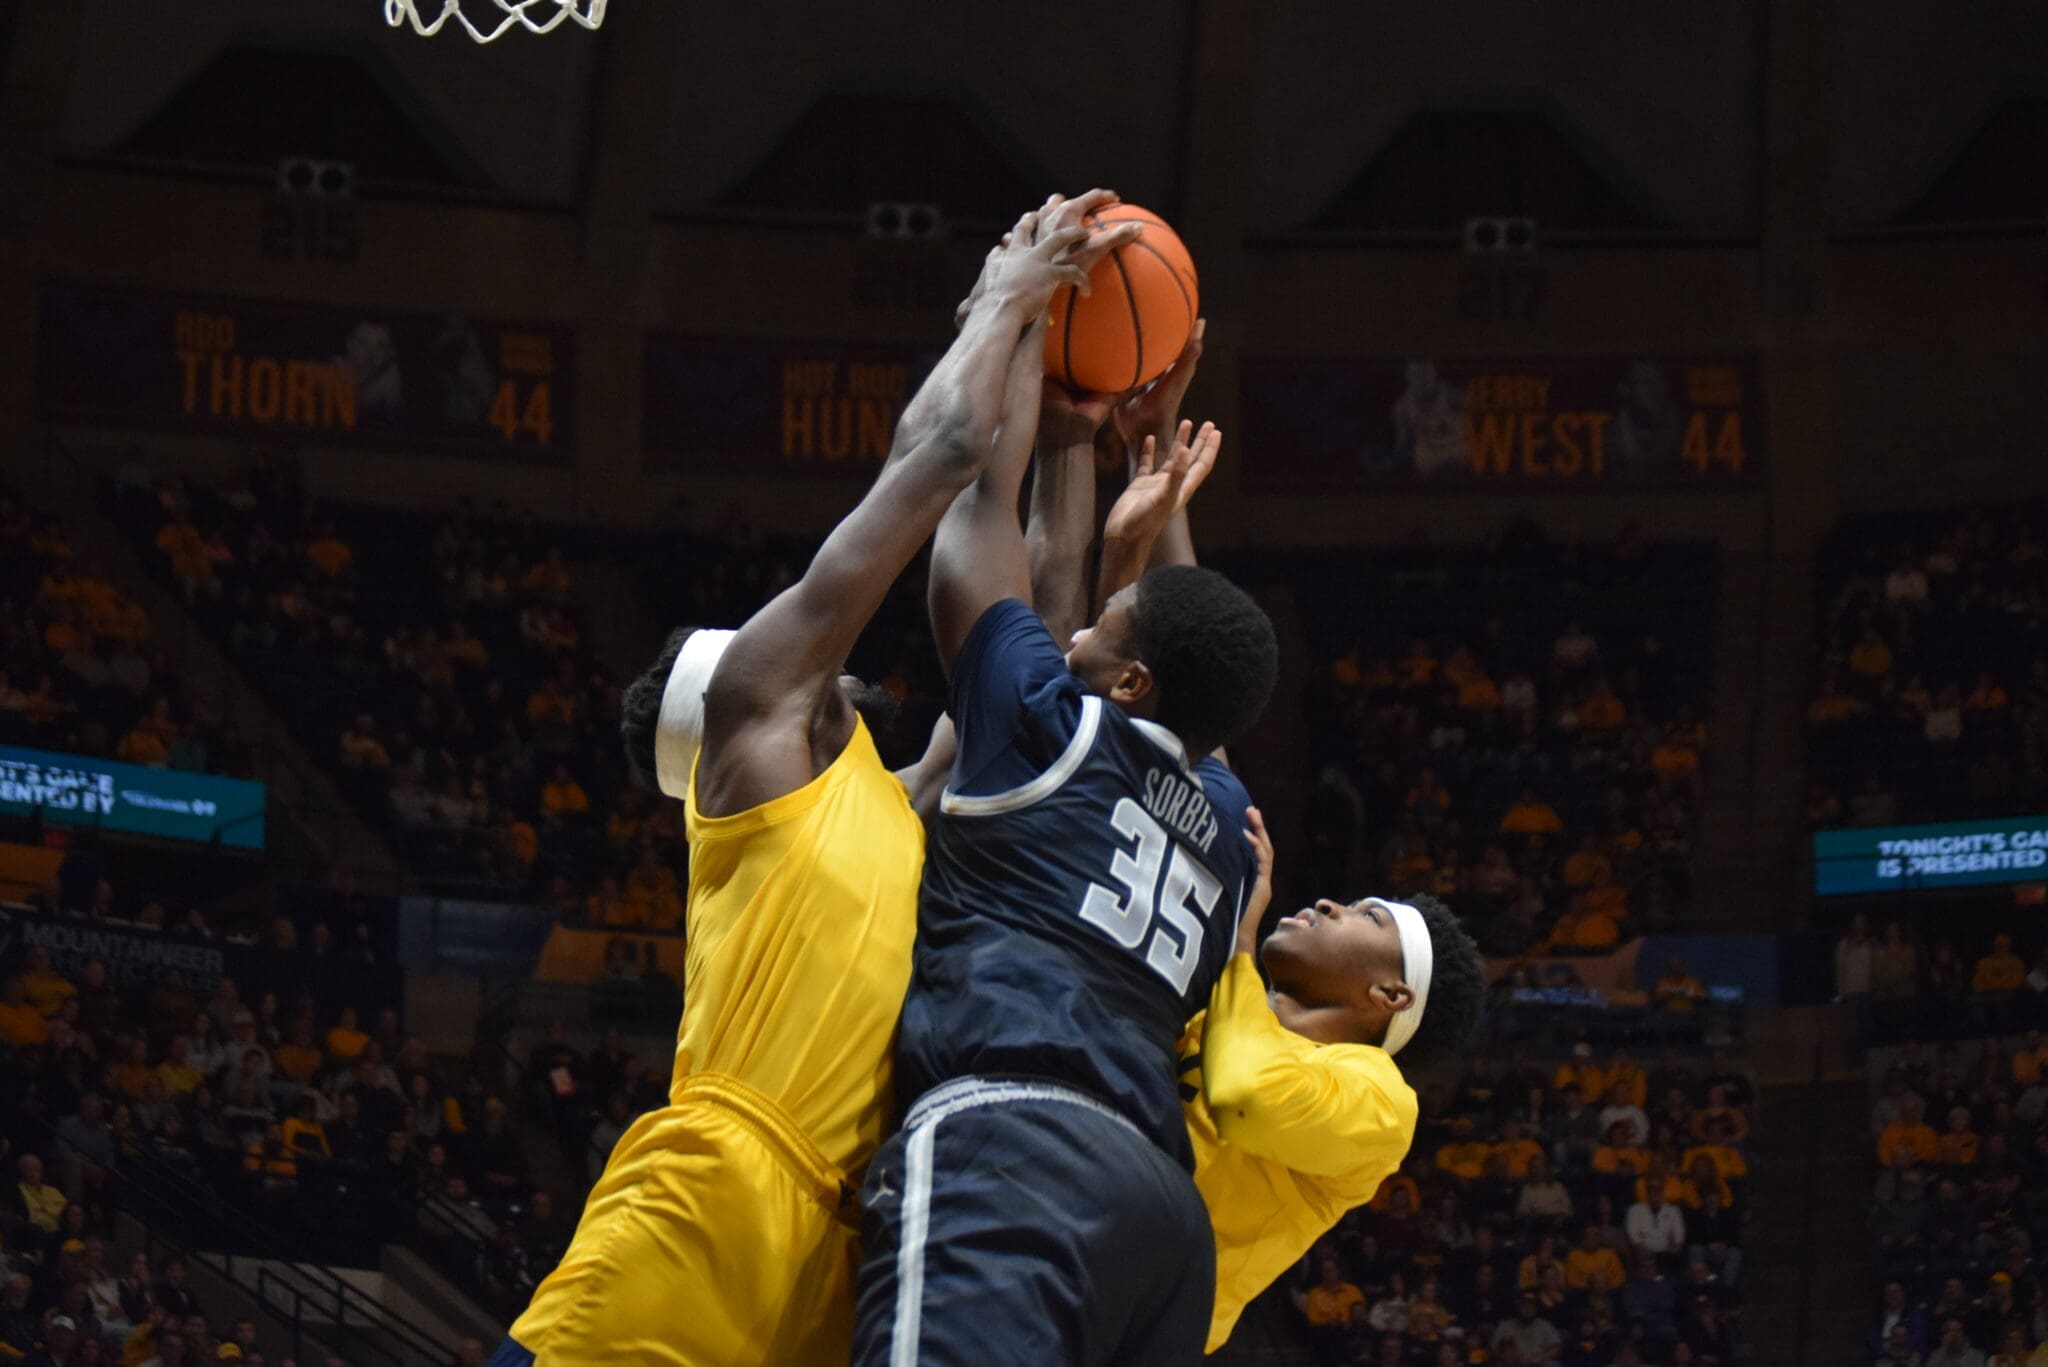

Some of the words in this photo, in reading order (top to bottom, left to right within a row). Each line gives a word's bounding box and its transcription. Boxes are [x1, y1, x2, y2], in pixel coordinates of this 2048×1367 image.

[177, 352, 360, 430] THORN
[487, 378, 554, 444] 44
[1463, 411, 1611, 477] WEST
[1682, 411, 1746, 474] 44
[1142, 767, 1219, 854] SORBER
[1877, 857, 1902, 878] IS
[1905, 848, 2047, 877] PRESENTED
[1878, 832, 2007, 857] TONIGHT'S
[1079, 797, 1223, 998] 35
[23, 920, 225, 974] MOUNTAINEER
